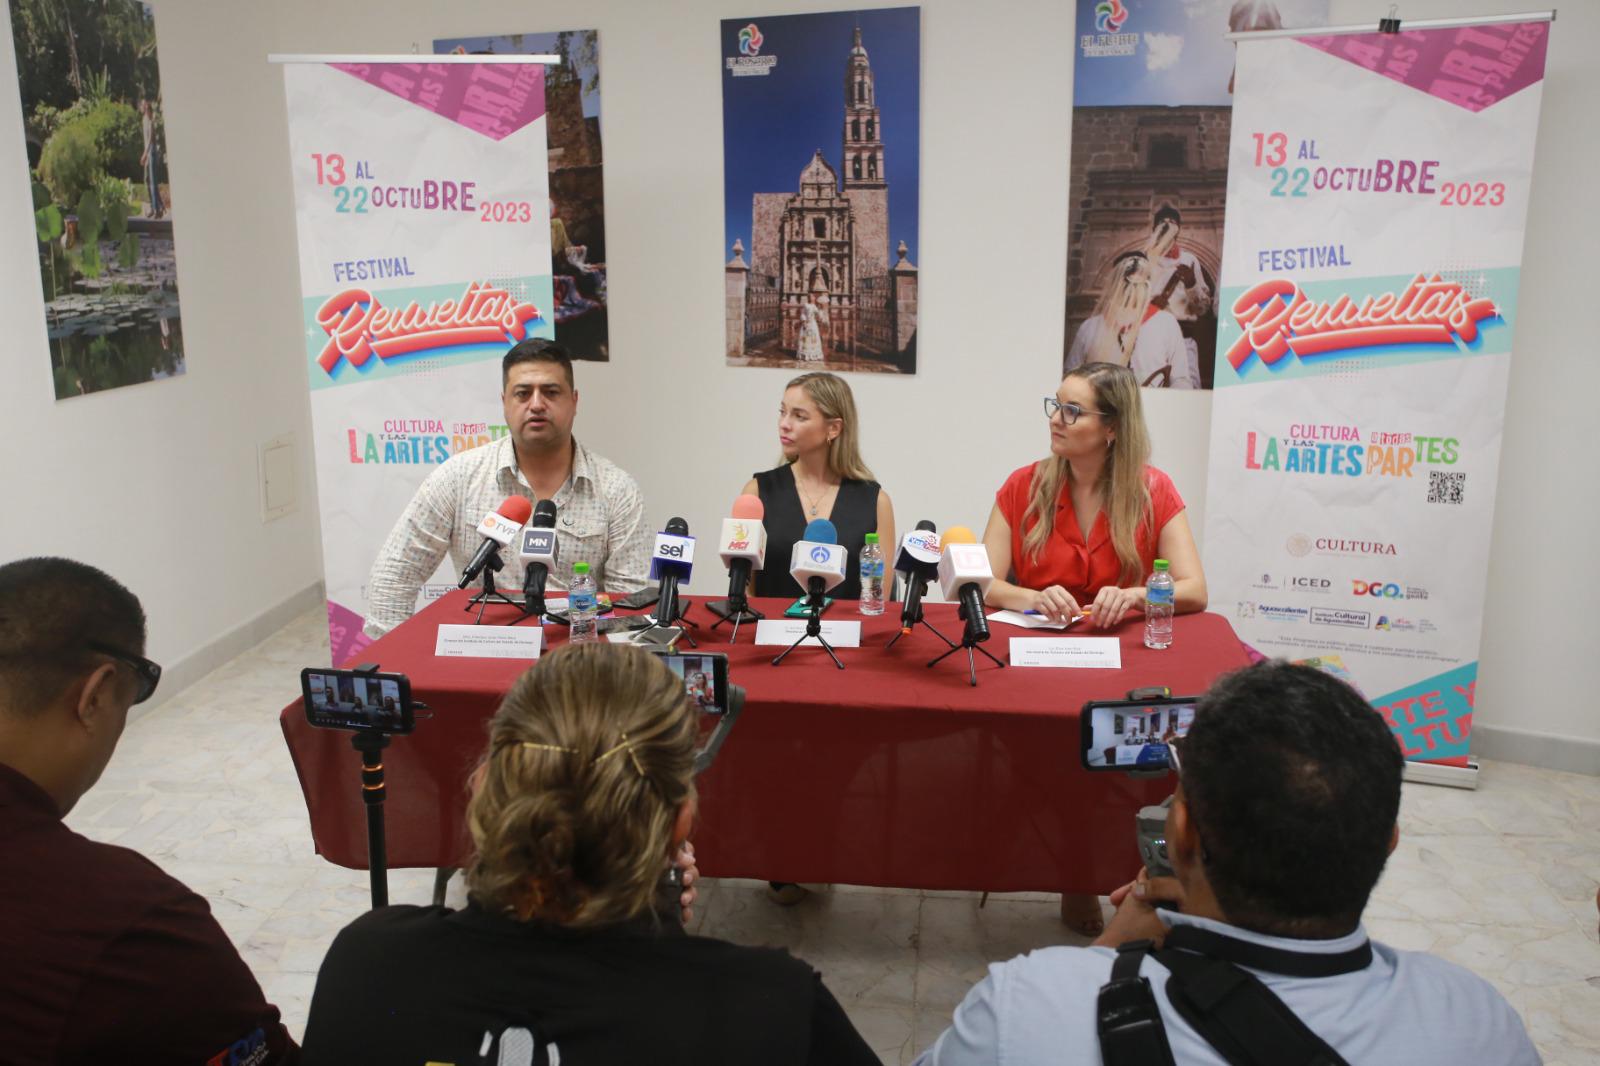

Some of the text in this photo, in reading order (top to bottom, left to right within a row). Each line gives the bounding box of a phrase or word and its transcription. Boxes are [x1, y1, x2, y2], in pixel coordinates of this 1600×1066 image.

[1252, 132, 1320, 168] 13 AL
[311, 153, 375, 186] 13 AL
[1270, 159, 1506, 207] 22 OCTUBRE 2023
[333, 180, 532, 223] 22 OCTUBRE 2023
[333, 256, 415, 282] FESTIVAL
[1258, 245, 1351, 272] FESTIVAL
[316, 281, 540, 365] Revueltas
[1228, 273, 1498, 367] Revueltas
[384, 420, 444, 434] CULTURA
[1289, 424, 1361, 442] CULTURA
[347, 429, 380, 464] LA
[384, 435, 450, 465] ARTES
[1246, 431, 1280, 472] LA
[1285, 443, 1364, 477] ARTES
[1292, 439, 1315, 448] LAS
[495, 522, 516, 536] TVP
[528, 538, 548, 547] MN
[660, 544, 684, 558] sel
[1315, 538, 1398, 556] CULTURA
[1291, 577, 1332, 588] ICED
[1334, 612, 1366, 621] Cultural
[1378, 690, 1448, 727] RTE
